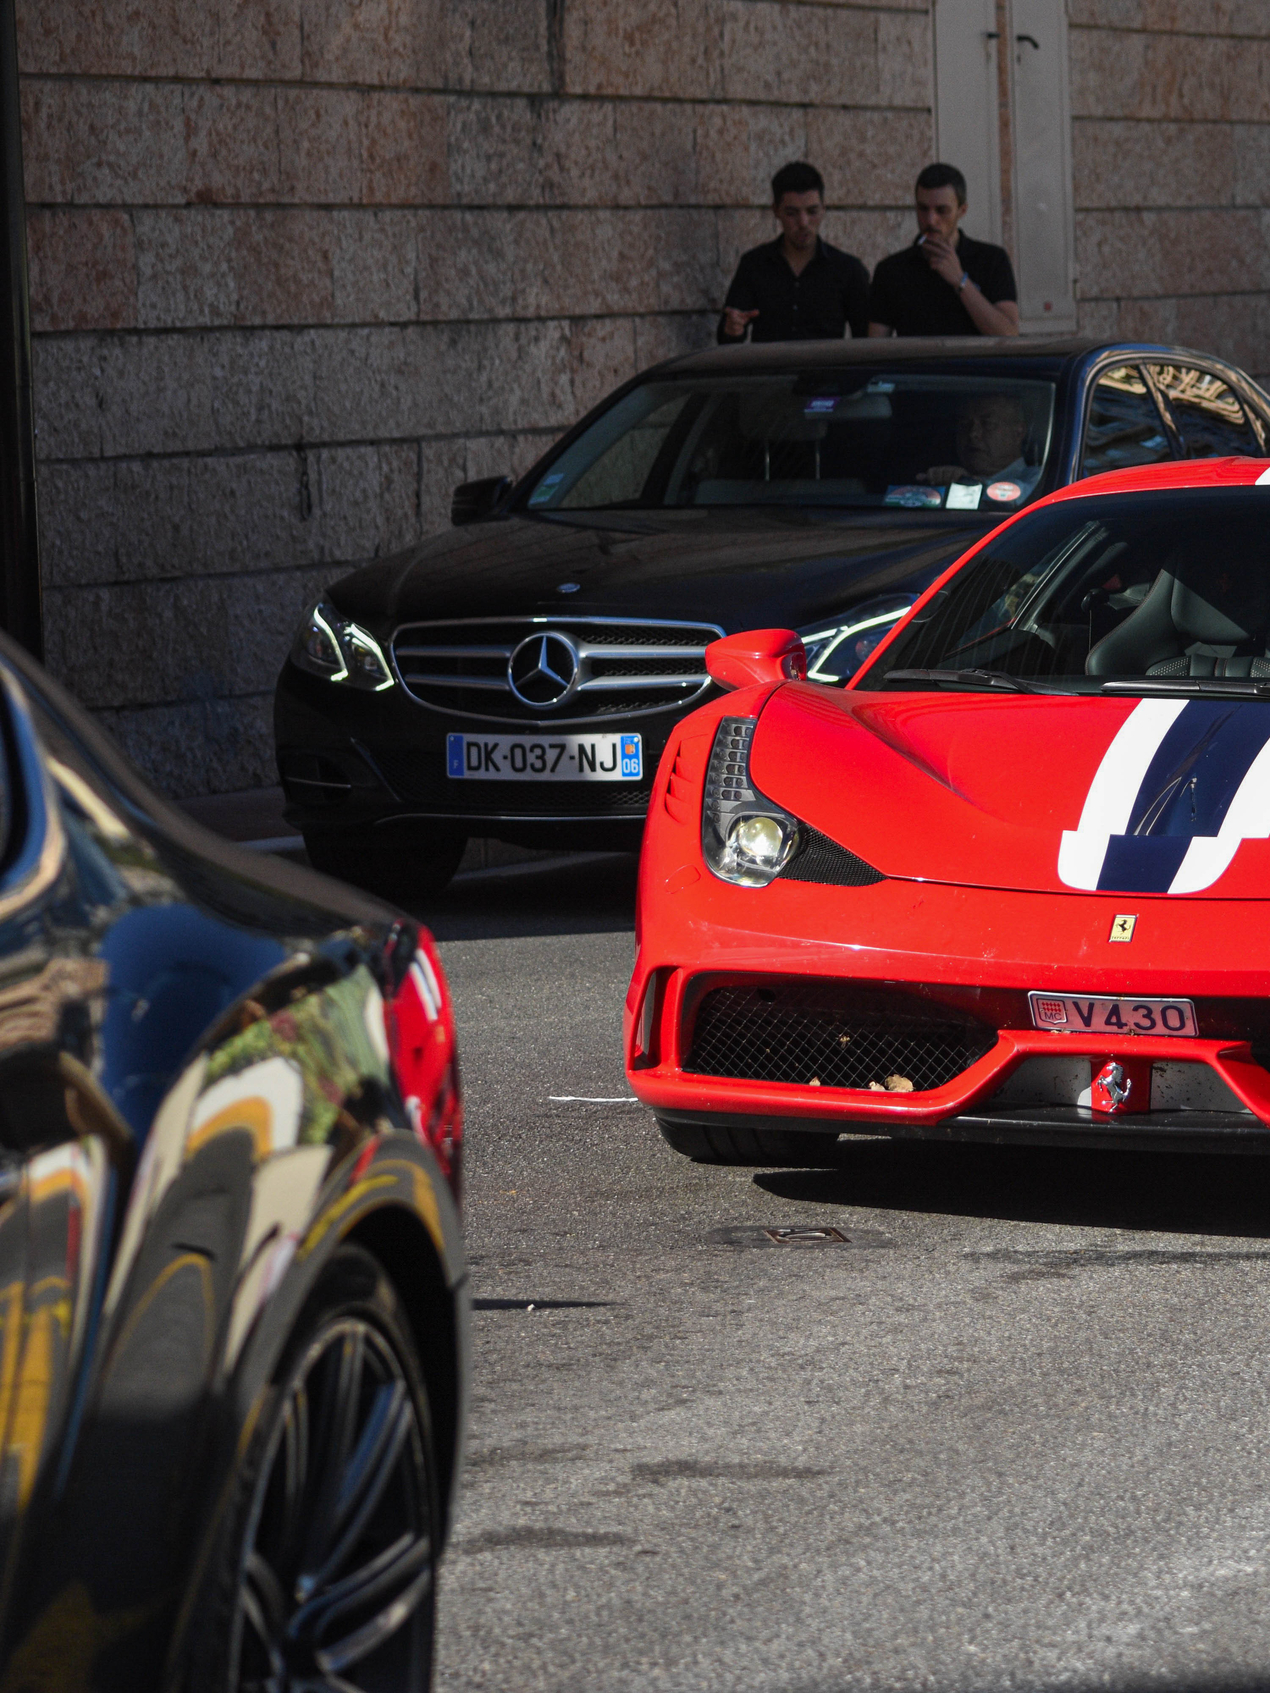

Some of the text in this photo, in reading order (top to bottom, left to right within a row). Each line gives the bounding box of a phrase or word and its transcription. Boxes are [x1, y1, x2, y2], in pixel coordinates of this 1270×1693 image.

[467, 742, 617, 772] DK-037-NJ
[622, 758, 639, 774] 06
[1044, 1001, 1186, 1031] MC V430
